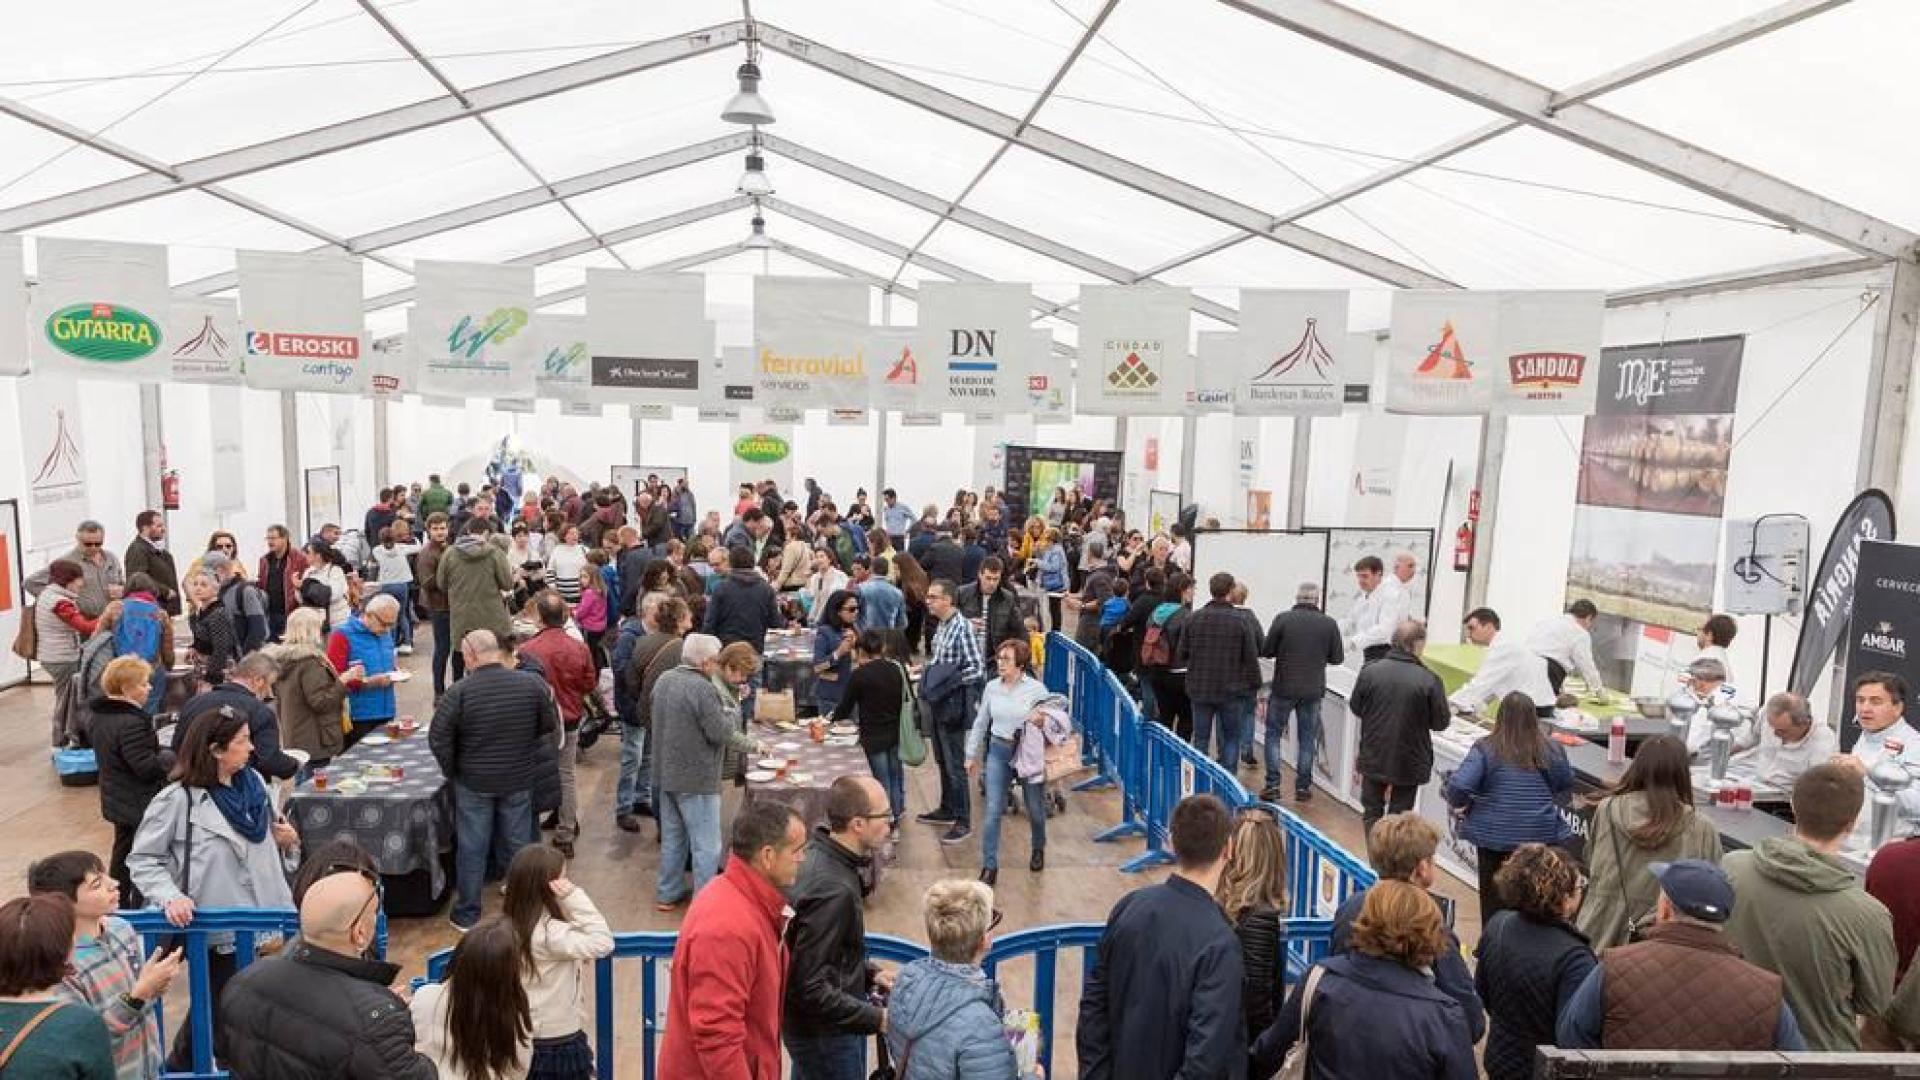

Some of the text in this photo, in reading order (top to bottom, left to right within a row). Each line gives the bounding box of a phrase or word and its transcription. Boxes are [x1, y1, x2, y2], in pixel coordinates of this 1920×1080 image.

[279, 336, 353, 355] EROSKI
[951, 329, 997, 357] DN
[1106, 340, 1161, 351] CIUDAD
[302, 362, 353, 384] contigo
[760, 349, 863, 376] ferrovial
[1516, 356, 1579, 378] SANDUA
[949, 387, 996, 397] NAVARRA
[1861, 632, 1906, 653] AMBAR
[1556, 805, 1591, 840] MBA
